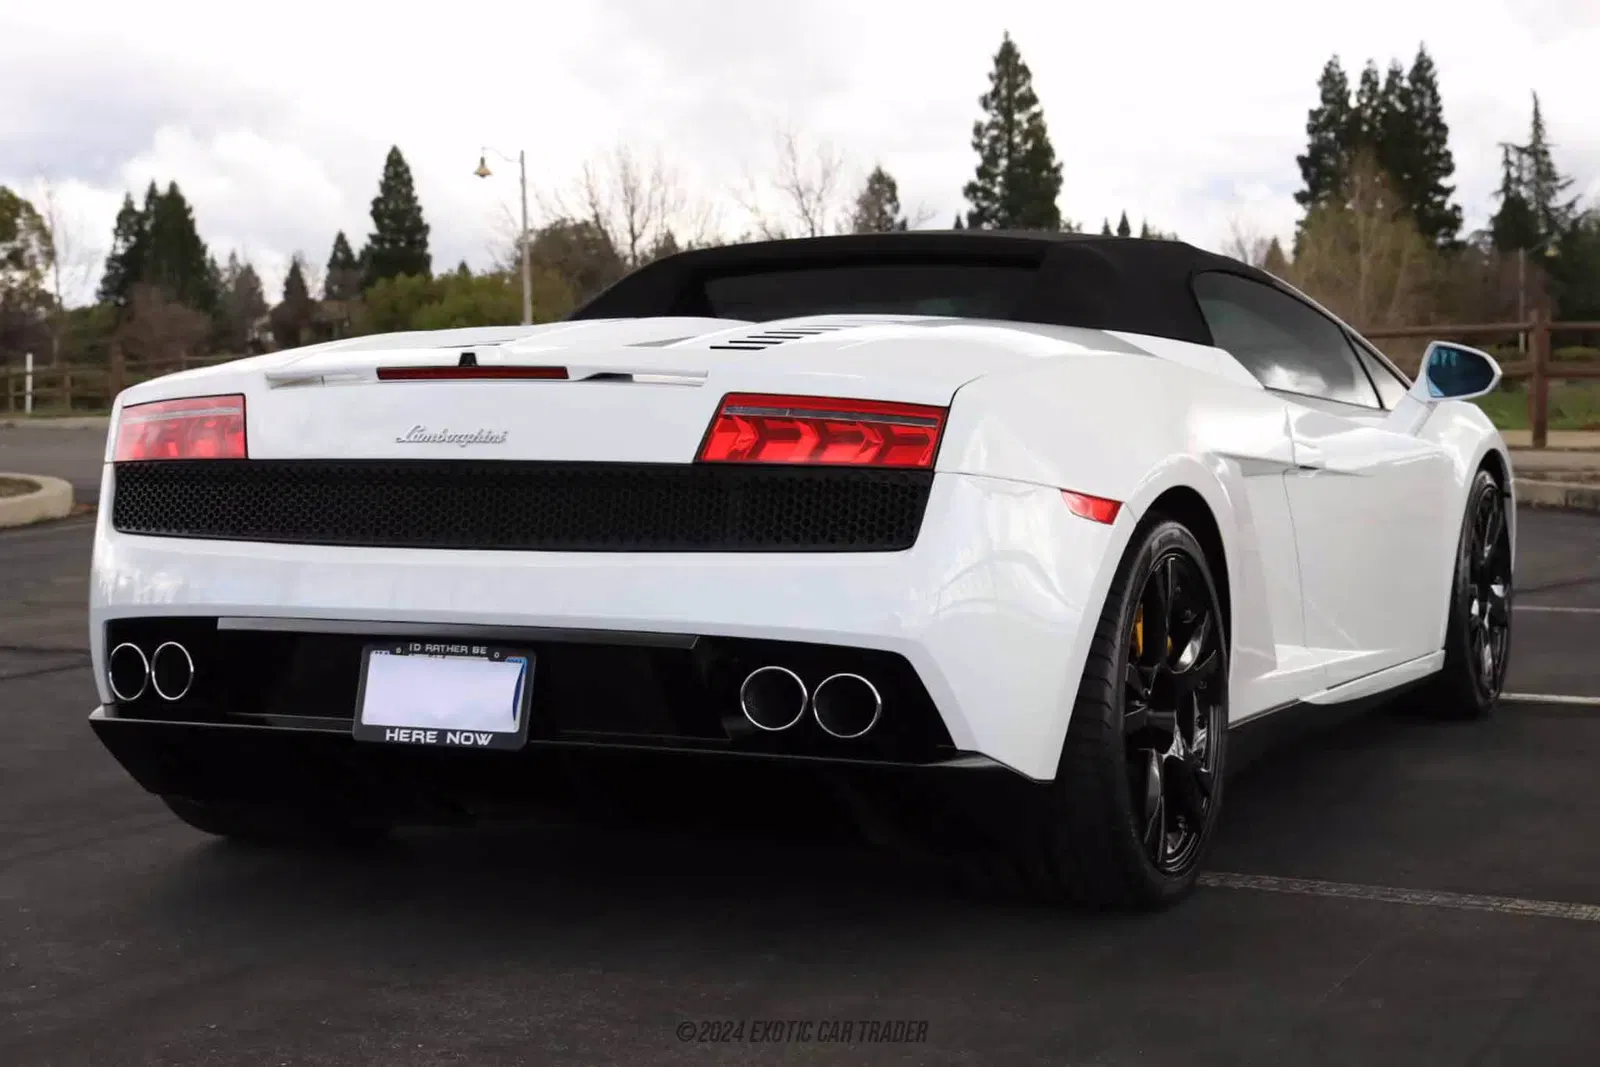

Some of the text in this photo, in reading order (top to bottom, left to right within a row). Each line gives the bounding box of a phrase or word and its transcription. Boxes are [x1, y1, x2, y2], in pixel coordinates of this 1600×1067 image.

[395, 424, 508, 448] Lamborghini
[425, 643, 468, 655] RATHER
[472, 645, 488, 655] BE
[385, 727, 493, 746] HERE NOW
